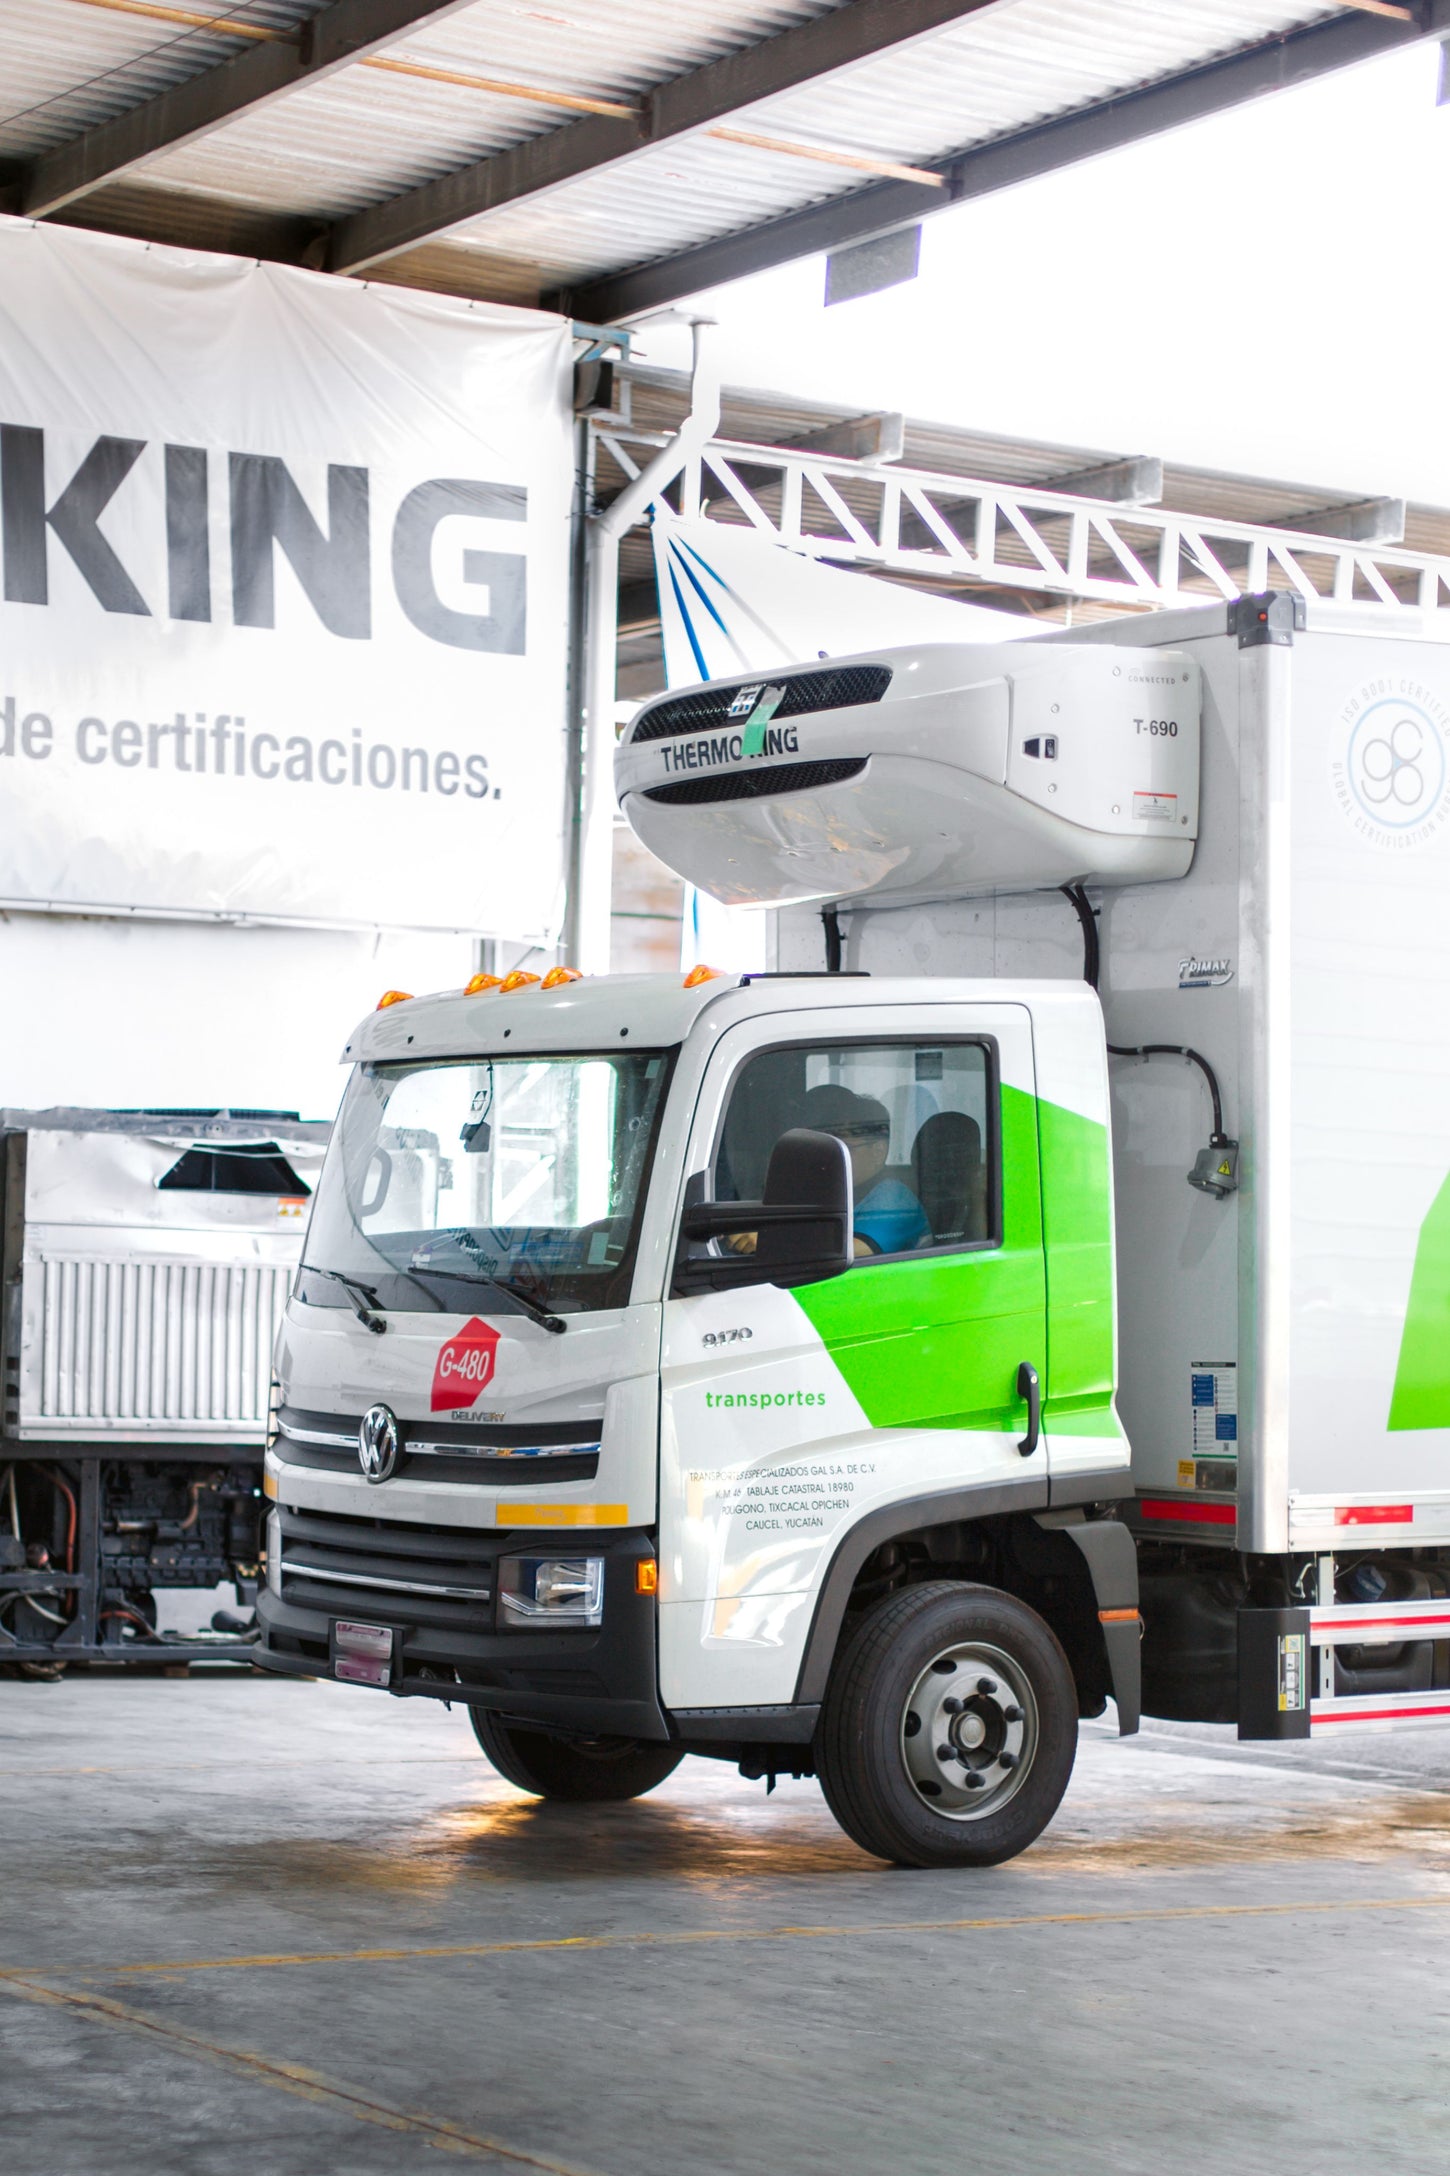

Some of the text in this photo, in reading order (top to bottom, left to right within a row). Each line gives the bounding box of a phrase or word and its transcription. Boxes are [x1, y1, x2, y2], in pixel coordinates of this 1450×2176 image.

[0, 422, 528, 656] KING
[1128, 675, 1176, 685] CONNECTED
[1361, 678, 1394, 702] 9001
[1133, 719, 1178, 737] T-690
[75, 712, 502, 800] certificaciones.
[661, 726, 799, 772] THERMO ING
[440, 1347, 490, 1381] G-480
[706, 1390, 826, 1409] transportes
[451, 1411, 506, 1422] DELIVERY
[745, 1467, 808, 1480] ESPECIALIZADOS
[811, 1466, 827, 1475] GAL
[847, 1464, 858, 1474] DE
[747, 1485, 779, 1496] TABLAJE
[781, 1484, 825, 1494] CATASTRAL
[828, 1482, 854, 1492] 18980
[769, 1501, 809, 1512] TIXCACAL
